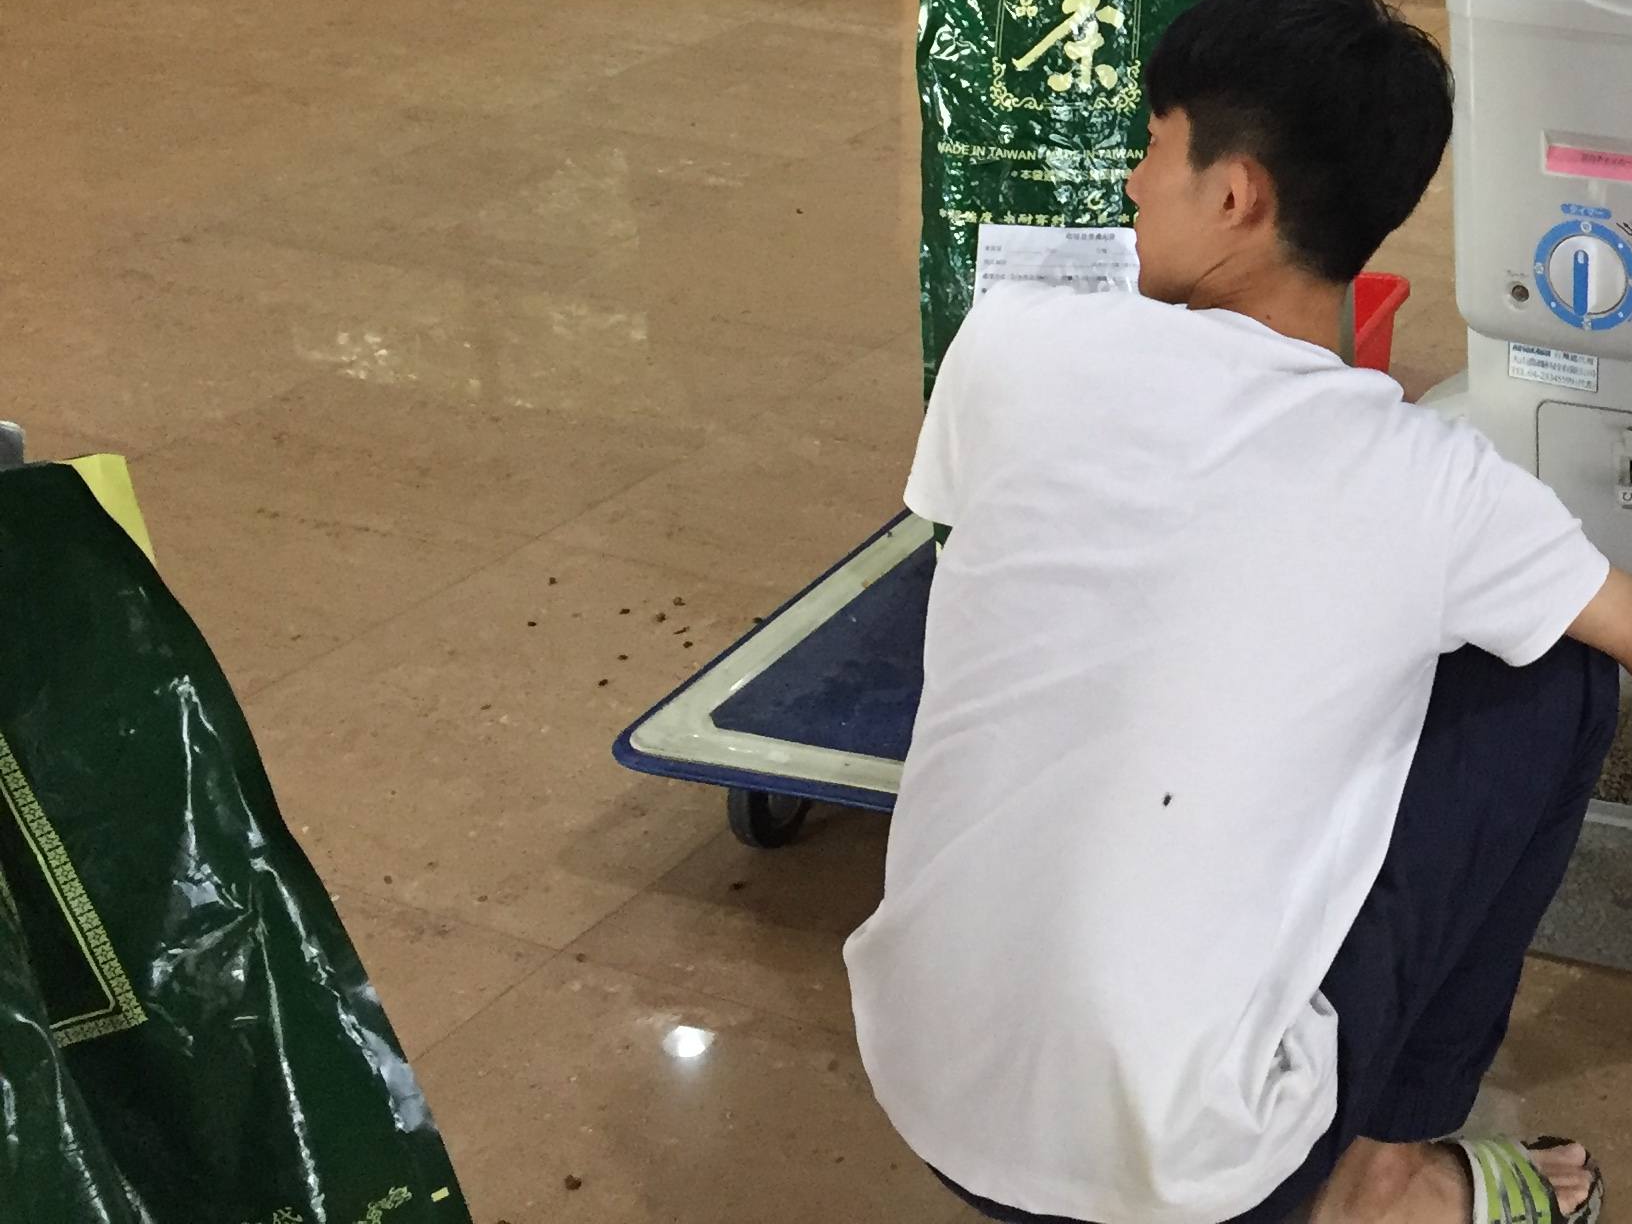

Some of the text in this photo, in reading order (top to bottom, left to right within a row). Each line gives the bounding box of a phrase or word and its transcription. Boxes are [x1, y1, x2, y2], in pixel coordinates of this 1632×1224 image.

[937, 141, 1037, 160] MADE IN TAIWAN
[1098, 149, 1145, 160] TAIWAN
